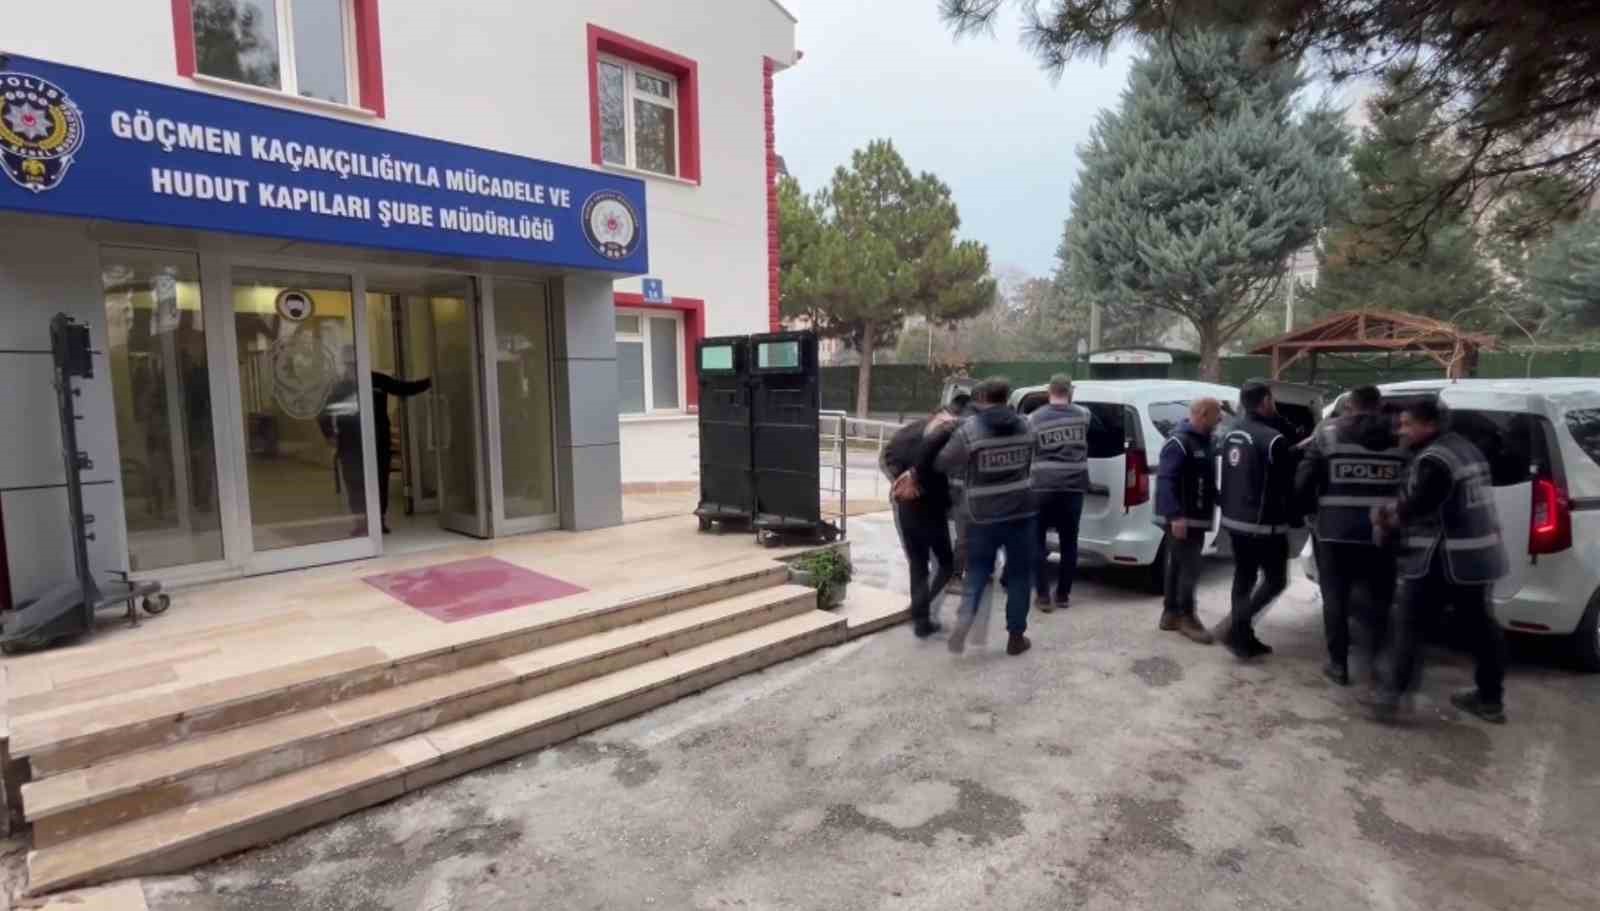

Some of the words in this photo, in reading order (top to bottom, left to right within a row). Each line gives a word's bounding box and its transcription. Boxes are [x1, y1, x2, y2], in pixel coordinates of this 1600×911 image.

[110, 109, 242, 156] GÖÇMEN
[250, 136, 441, 188] KAÇAKÇILIĞIYLA
[446, 168, 545, 205] MÜCADELE
[549, 186, 571, 209] VE
[151, 167, 249, 204] HUDUT
[258, 182, 371, 219] KAPILARI
[378, 200, 433, 228] ŞUBE
[440, 207, 554, 242] MÜDÜRLÜĞÜ
[1339, 464, 1393, 479] POLIS
